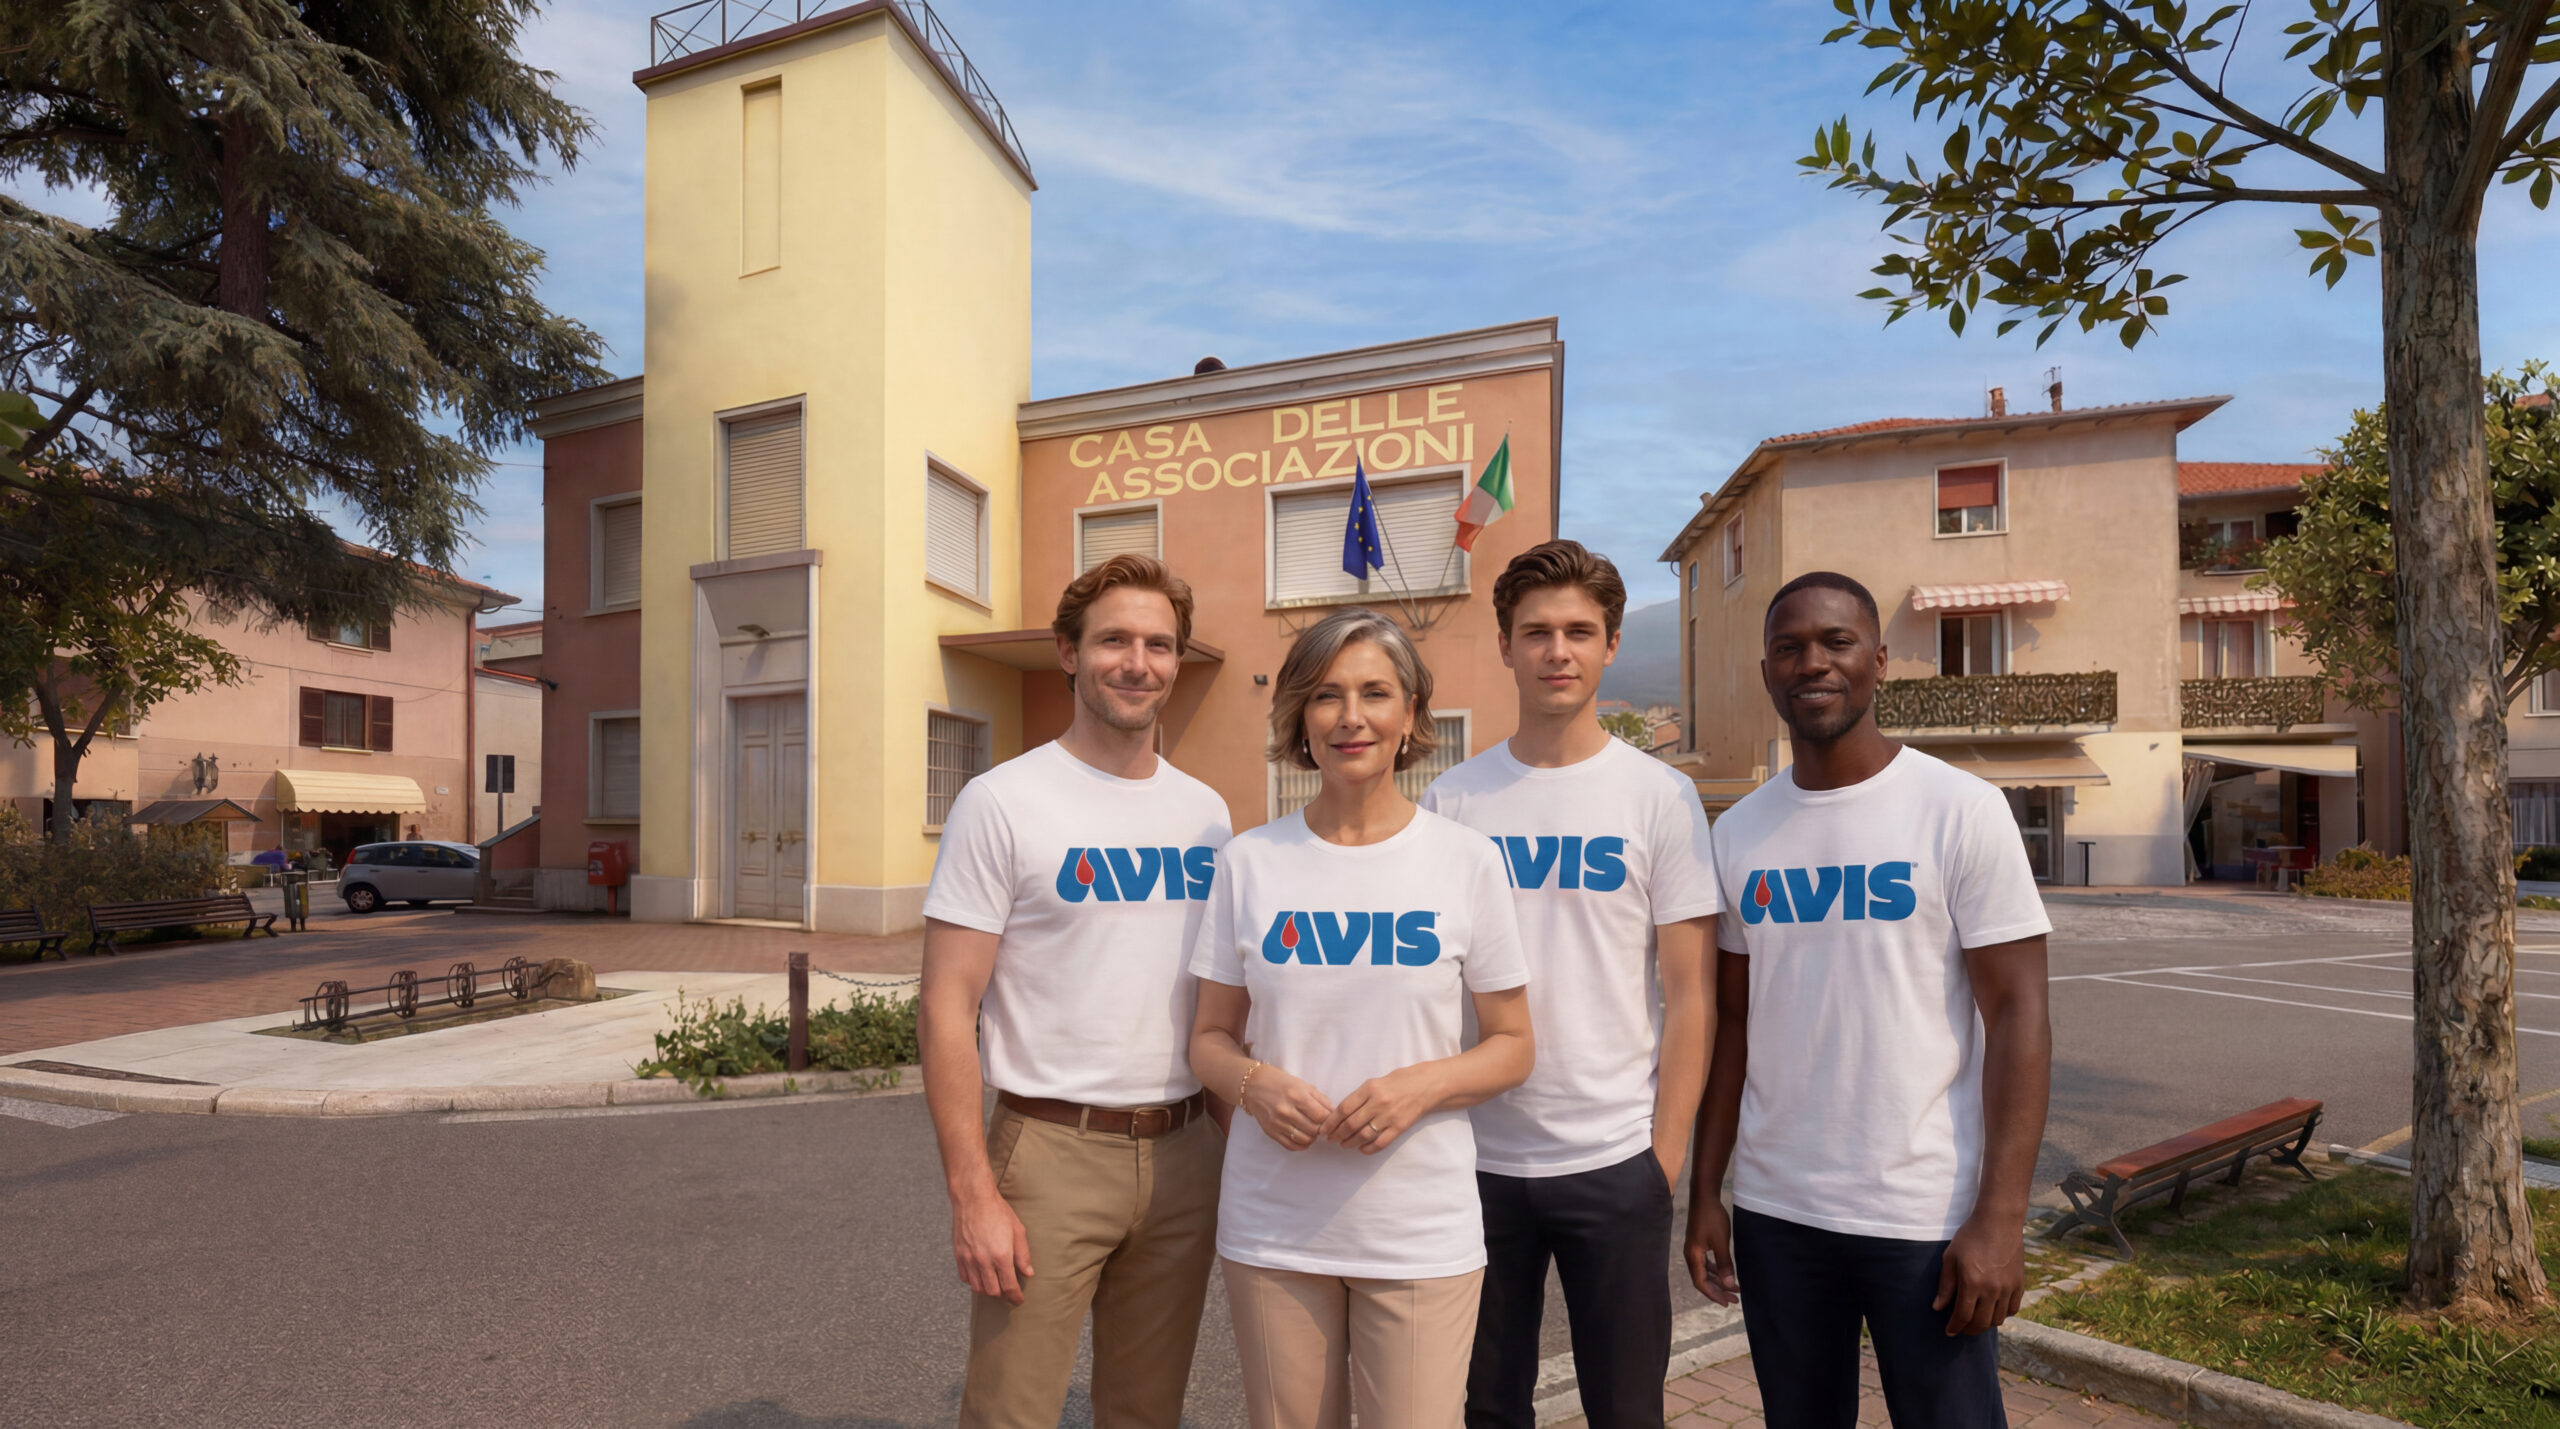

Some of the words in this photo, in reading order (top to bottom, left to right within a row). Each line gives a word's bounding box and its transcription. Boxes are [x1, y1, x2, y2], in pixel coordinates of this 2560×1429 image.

[1069, 422, 1212, 469] CASA
[1272, 383, 1465, 444] DELLE
[1085, 423, 1474, 505] ASSOCIAZIONI
[1056, 846, 1216, 903] AVIS
[1489, 836, 1627, 892] VIS
[1740, 861, 1916, 925] AVIS
[1262, 910, 1441, 967] AVIS
